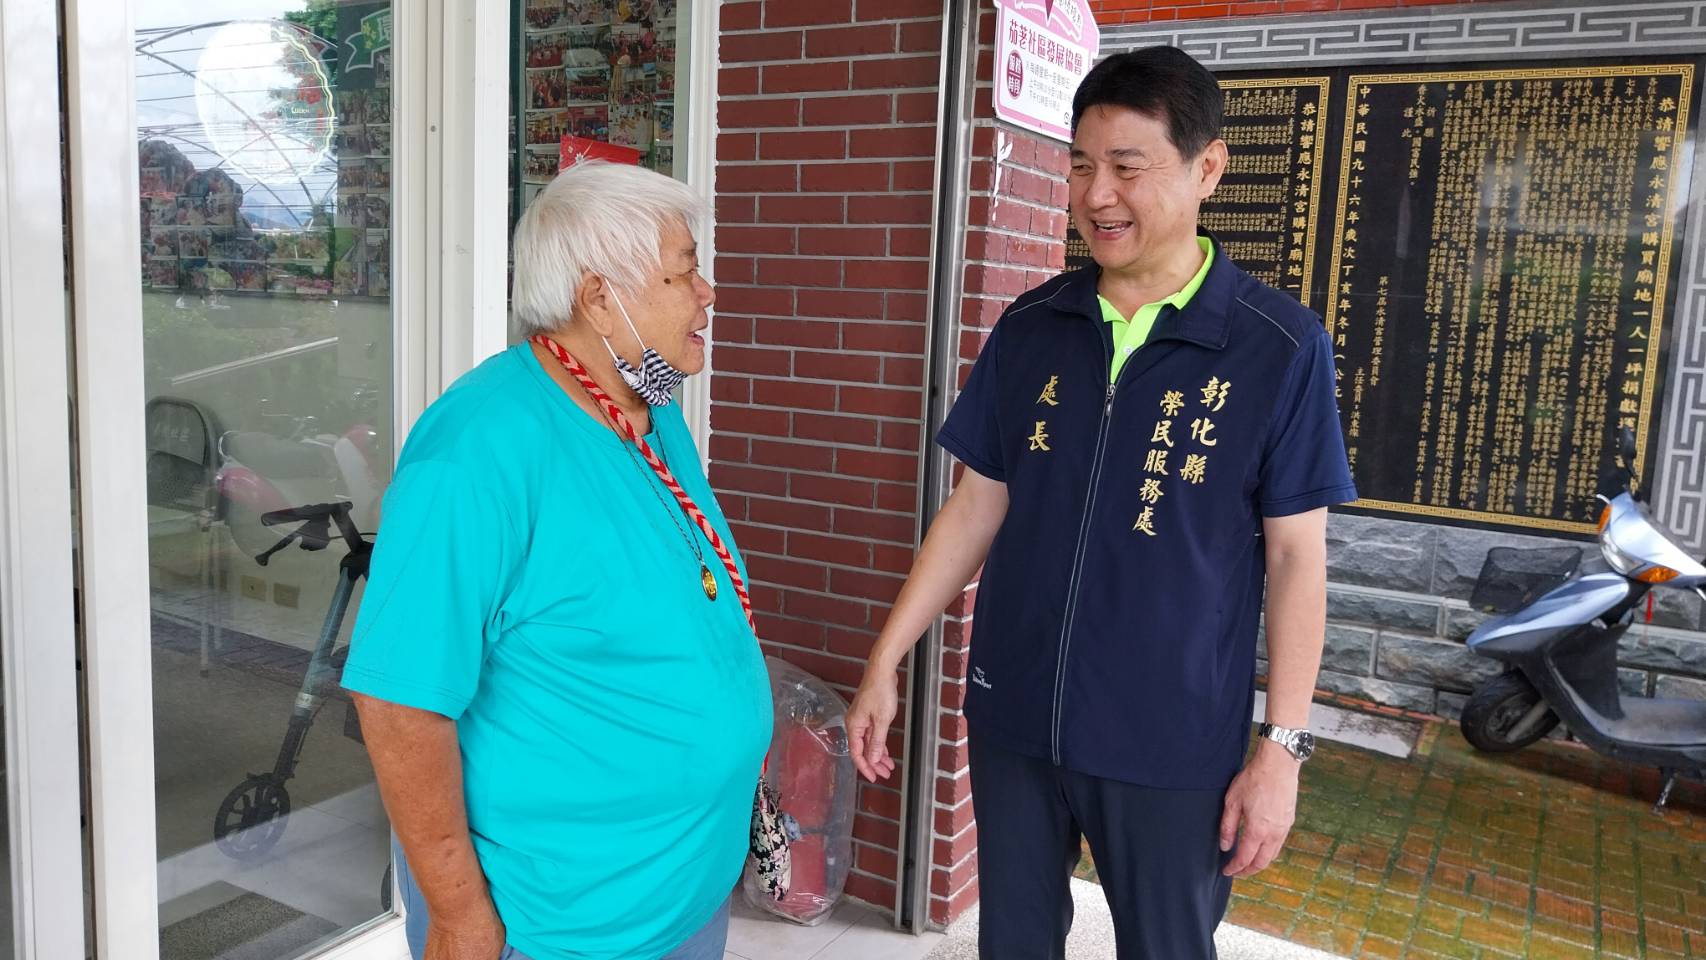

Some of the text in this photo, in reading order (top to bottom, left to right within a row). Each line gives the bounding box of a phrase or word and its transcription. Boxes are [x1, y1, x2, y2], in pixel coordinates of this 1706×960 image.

[1028, 375, 1060, 451] 處長
[1132, 390, 1186, 537] 榮民服務處
[1179, 376, 1232, 485] 彰化縣
